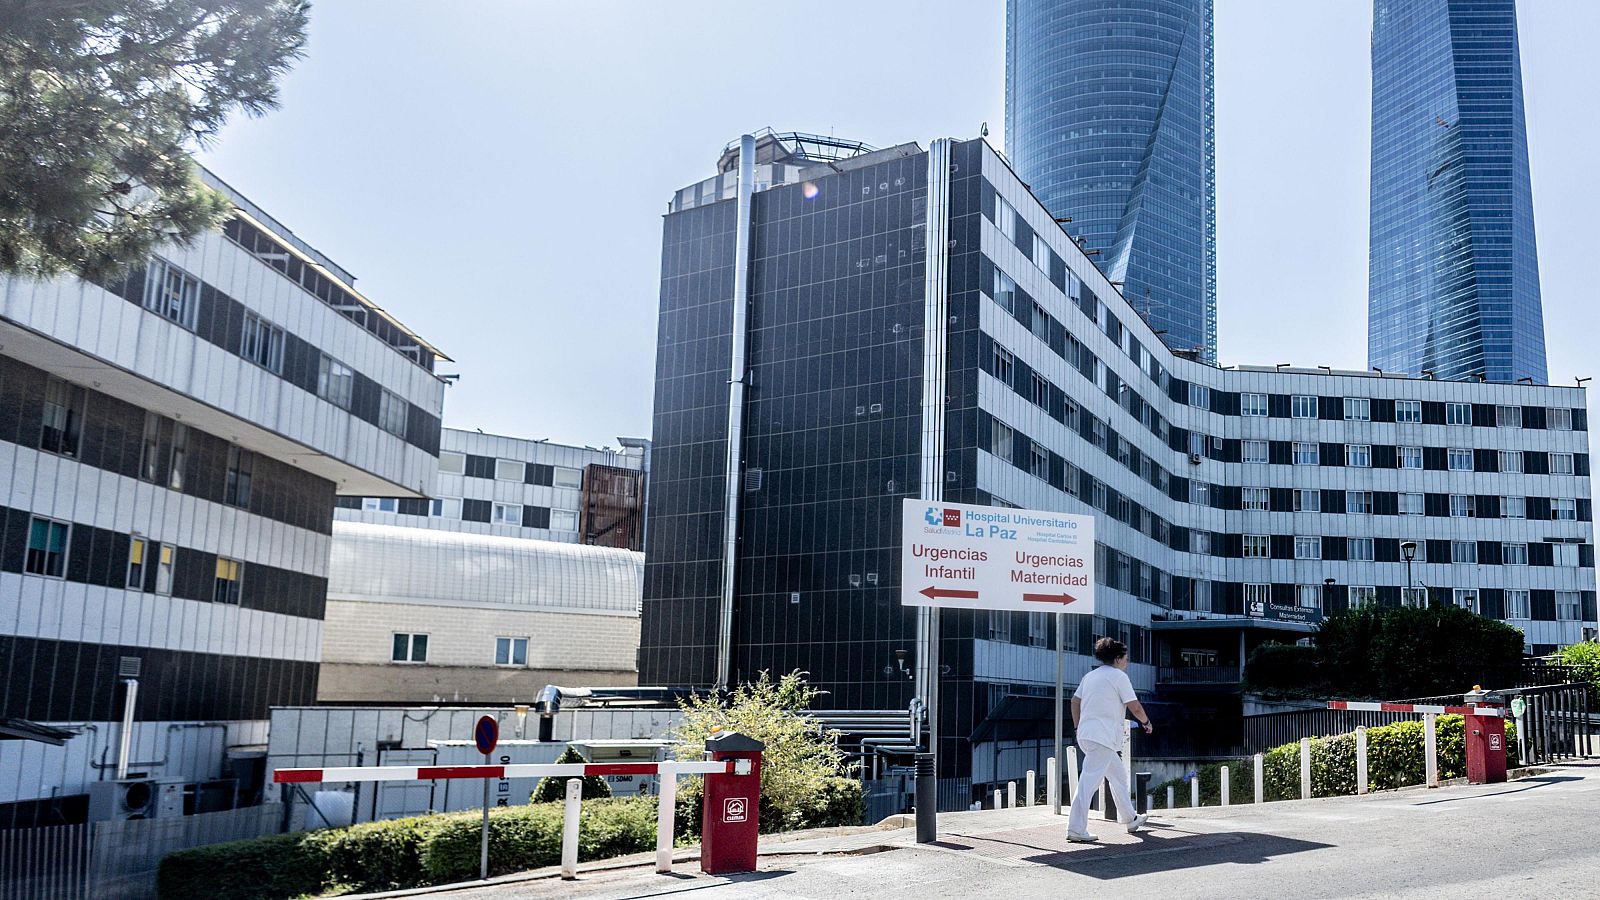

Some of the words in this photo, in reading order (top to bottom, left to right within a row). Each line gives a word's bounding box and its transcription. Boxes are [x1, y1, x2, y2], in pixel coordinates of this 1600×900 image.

[966, 510, 1009, 523] Hospital
[1013, 514, 1077, 529] Universitario
[966, 523, 984, 537] La
[989, 525, 1017, 540] Paz
[912, 543, 988, 561] Urgencias
[1015, 551, 1084, 568] Urgencias
[925, 564, 975, 580] Infantil
[1010, 569, 1088, 586] Maternidad
[1269, 603, 1293, 612] Consultas
[1294, 605, 1314, 614] Externas
[1279, 612, 1306, 620] Maternidad
